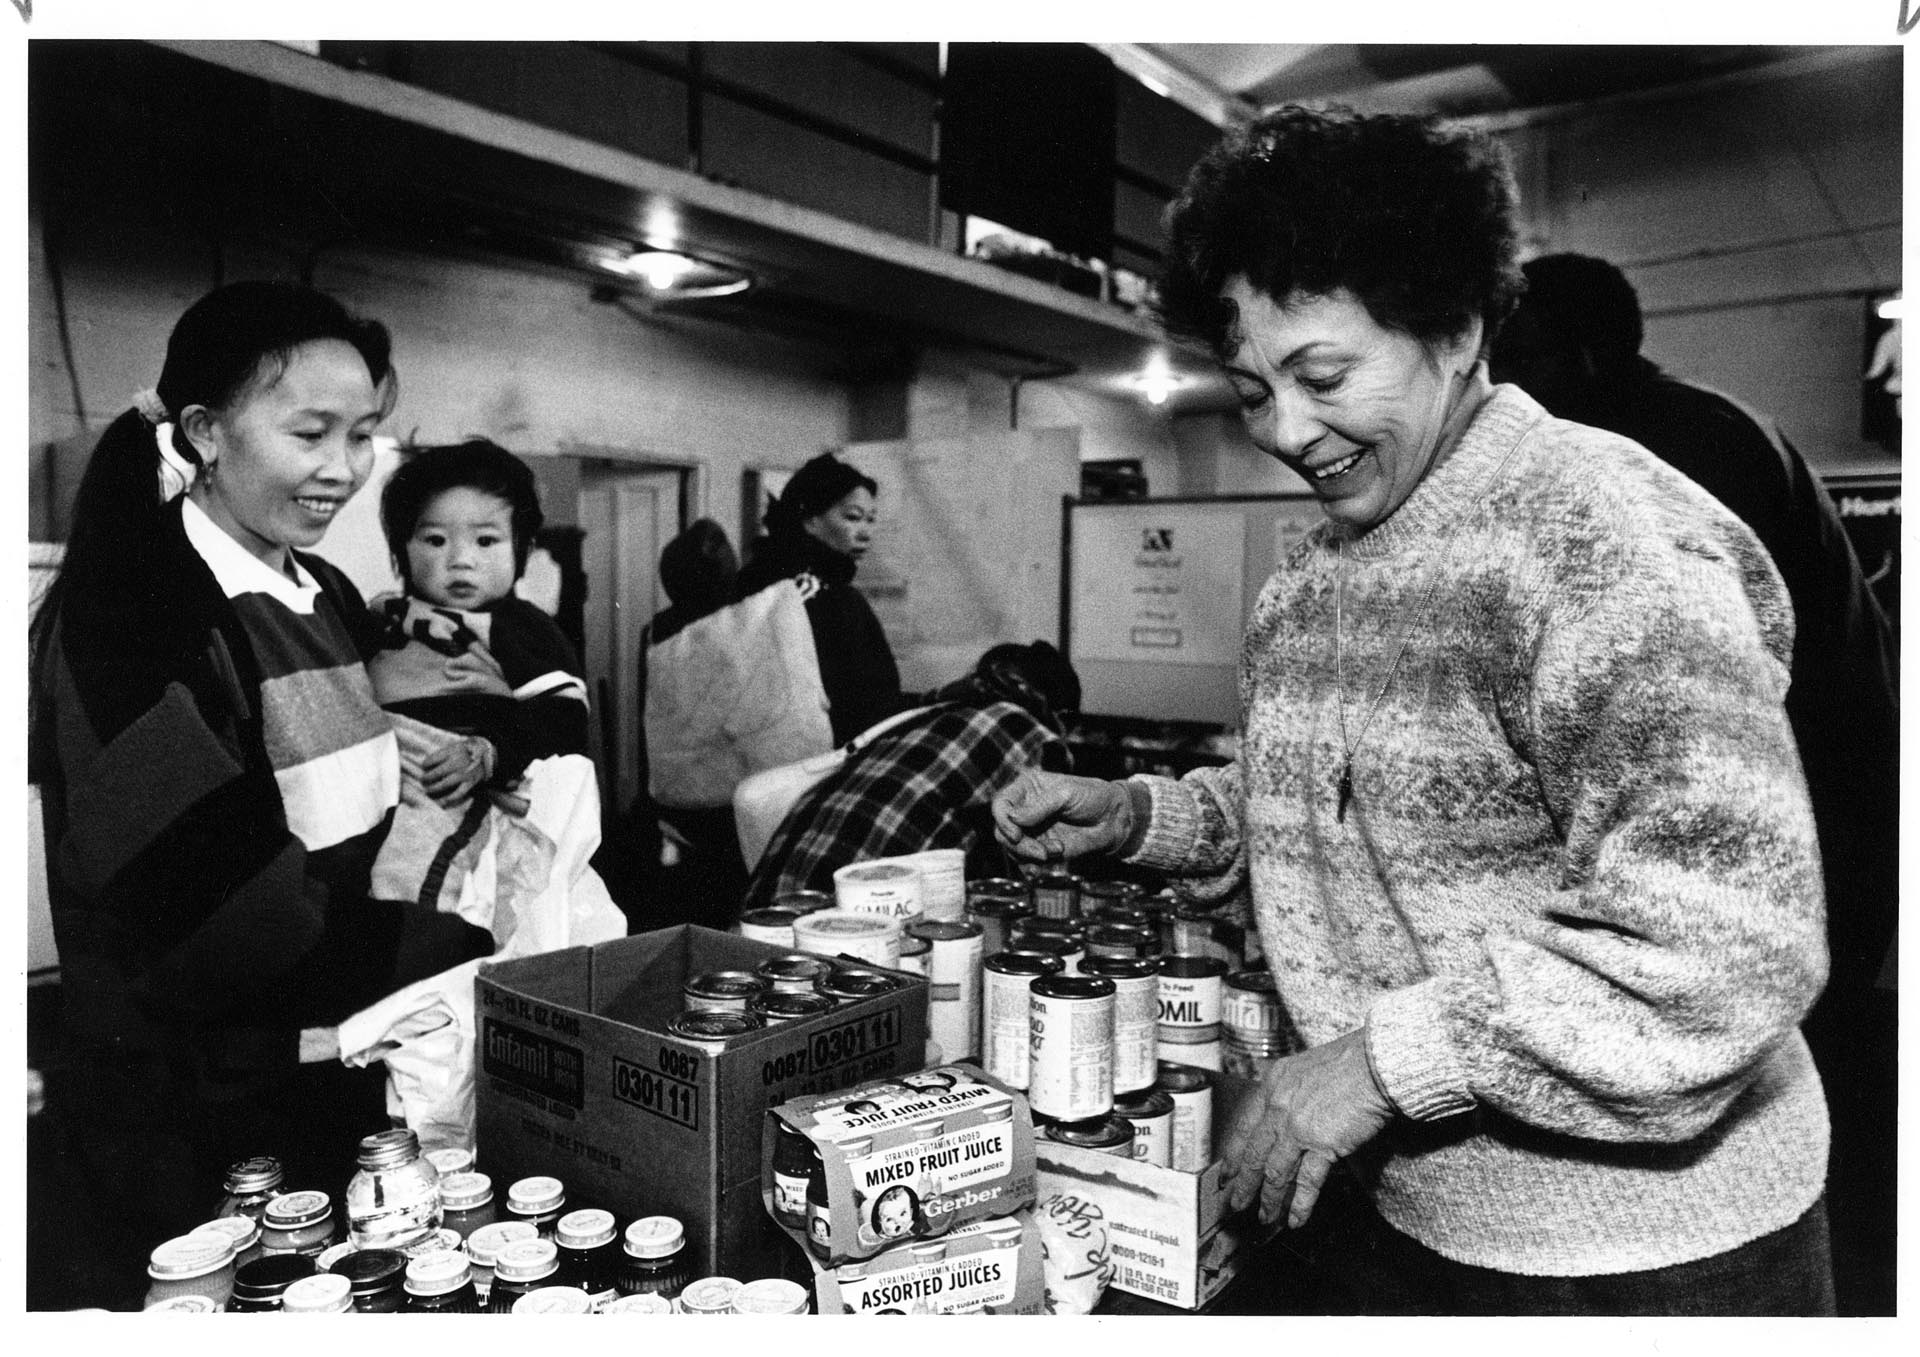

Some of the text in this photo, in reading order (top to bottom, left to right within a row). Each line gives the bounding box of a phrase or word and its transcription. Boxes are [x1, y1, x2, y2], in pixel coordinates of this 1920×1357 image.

[489, 1025, 548, 1079] Enfamil
[659, 1047, 699, 1082] 0087
[762, 1049, 807, 1086] 0087
[843, 1087, 991, 1129] MIXED FRUIT JUICE
[958, 1131, 981, 1145] ADDED
[866, 1136, 1003, 1187] MIXED FRUIT JUICE
[948, 1161, 1005, 1182] NO SUGAR ADDED
[923, 1185, 1002, 1218] Gerber
[958, 1258, 983, 1270] ADDED
[861, 1262, 1001, 1310] ASSORTED JUICES
[1125, 1278, 1140, 1289] NET
[1158, 1277, 1180, 1291] CANS
[943, 1293, 1006, 1312] NO SUGAR ADDED
